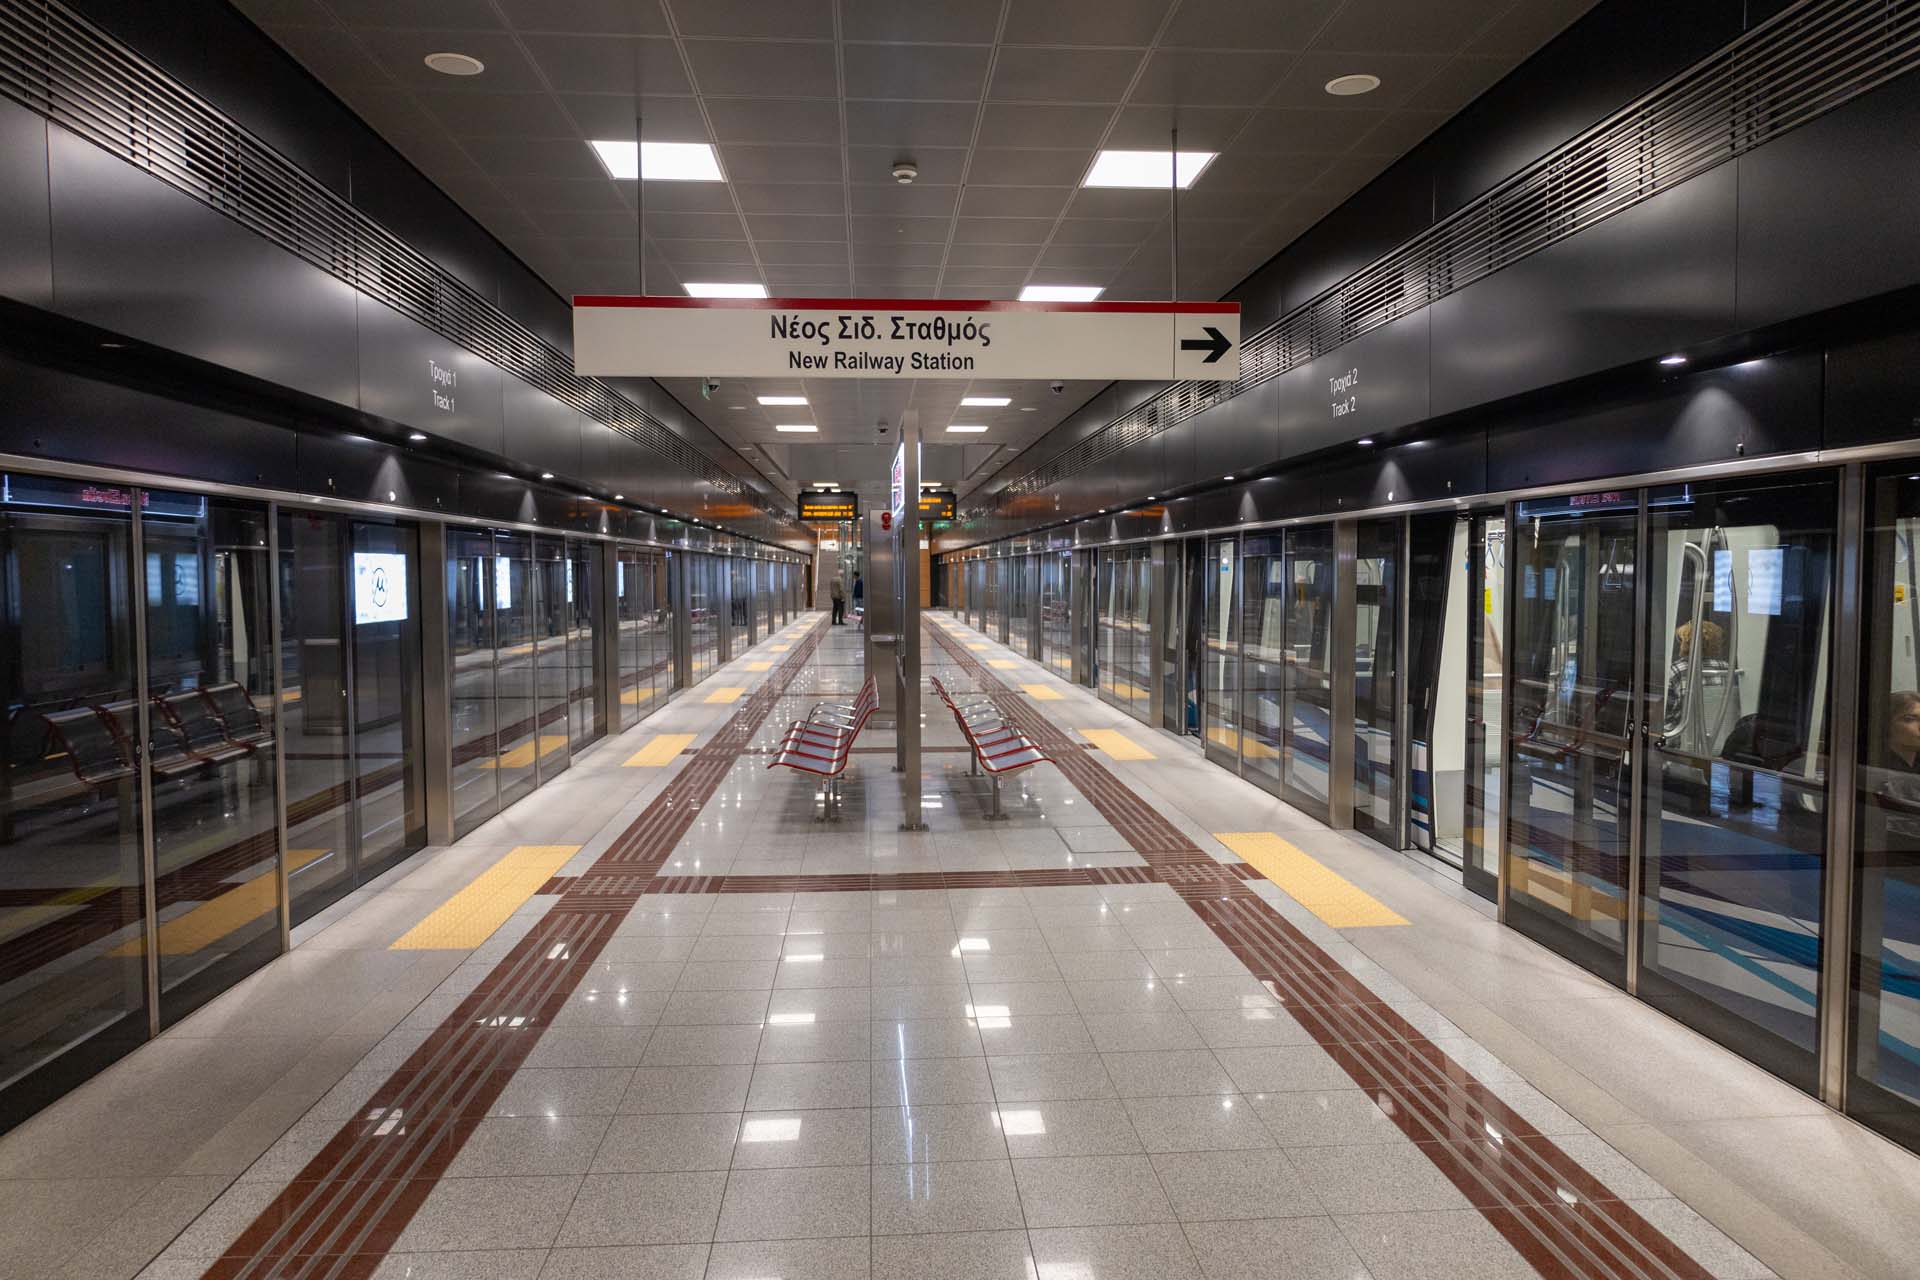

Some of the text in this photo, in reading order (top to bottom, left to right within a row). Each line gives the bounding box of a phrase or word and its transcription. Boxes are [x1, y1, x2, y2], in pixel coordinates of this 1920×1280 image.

[771, 314, 991, 347] Νέος Σιδ. Σταθμός
[789, 351, 974, 374] New Railway Station
[1329, 367, 1358, 397] Τροχιά 2
[432, 389, 450, 411] Track
[1331, 396, 1356, 419] Track 2
